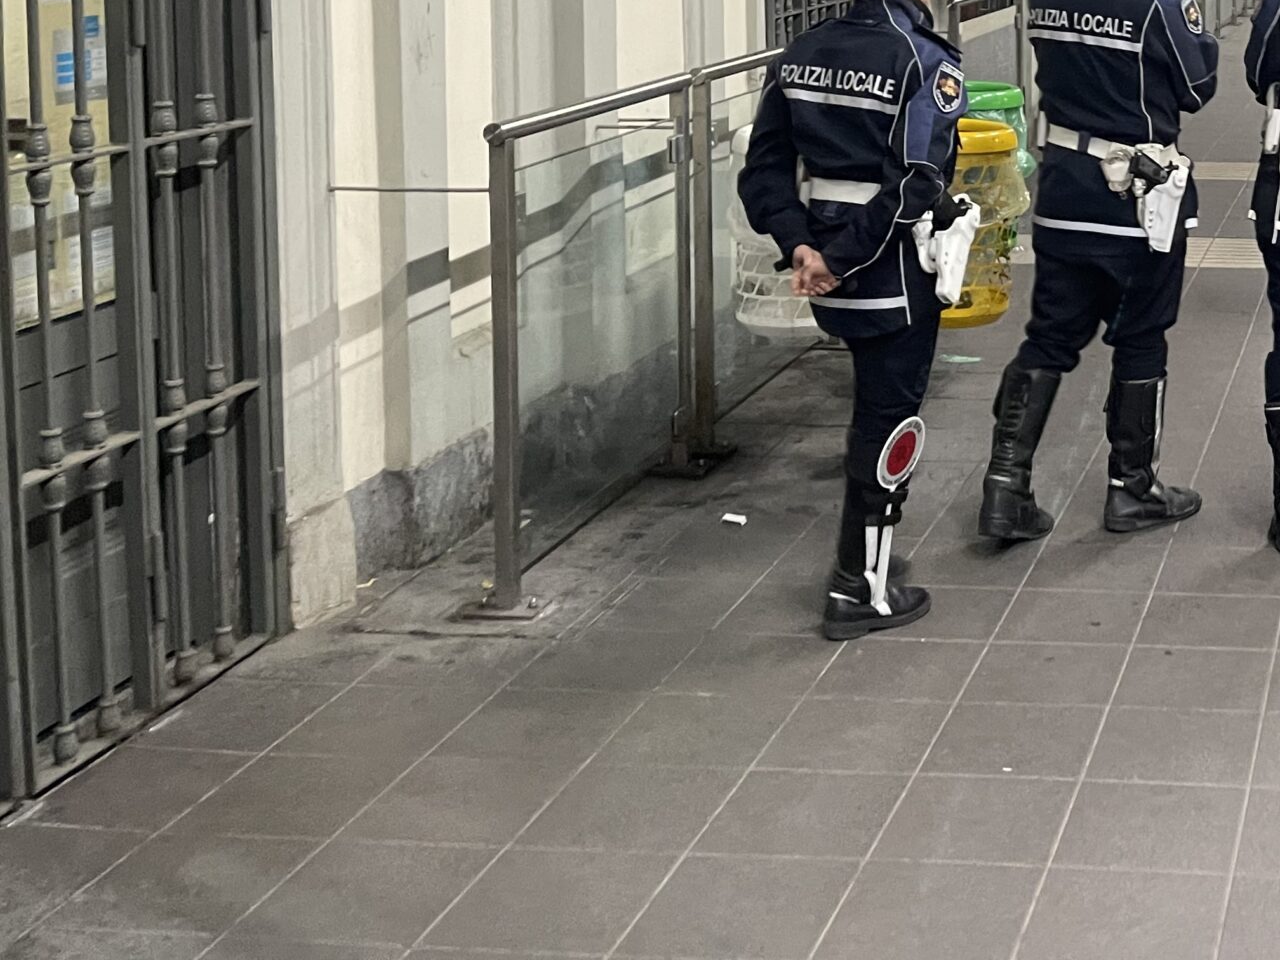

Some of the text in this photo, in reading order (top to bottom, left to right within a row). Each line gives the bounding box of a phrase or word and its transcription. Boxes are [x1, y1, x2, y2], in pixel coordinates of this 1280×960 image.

[1073, 12, 1134, 38] LOCALE
[781, 64, 896, 99] POLIZIA LOCALE
